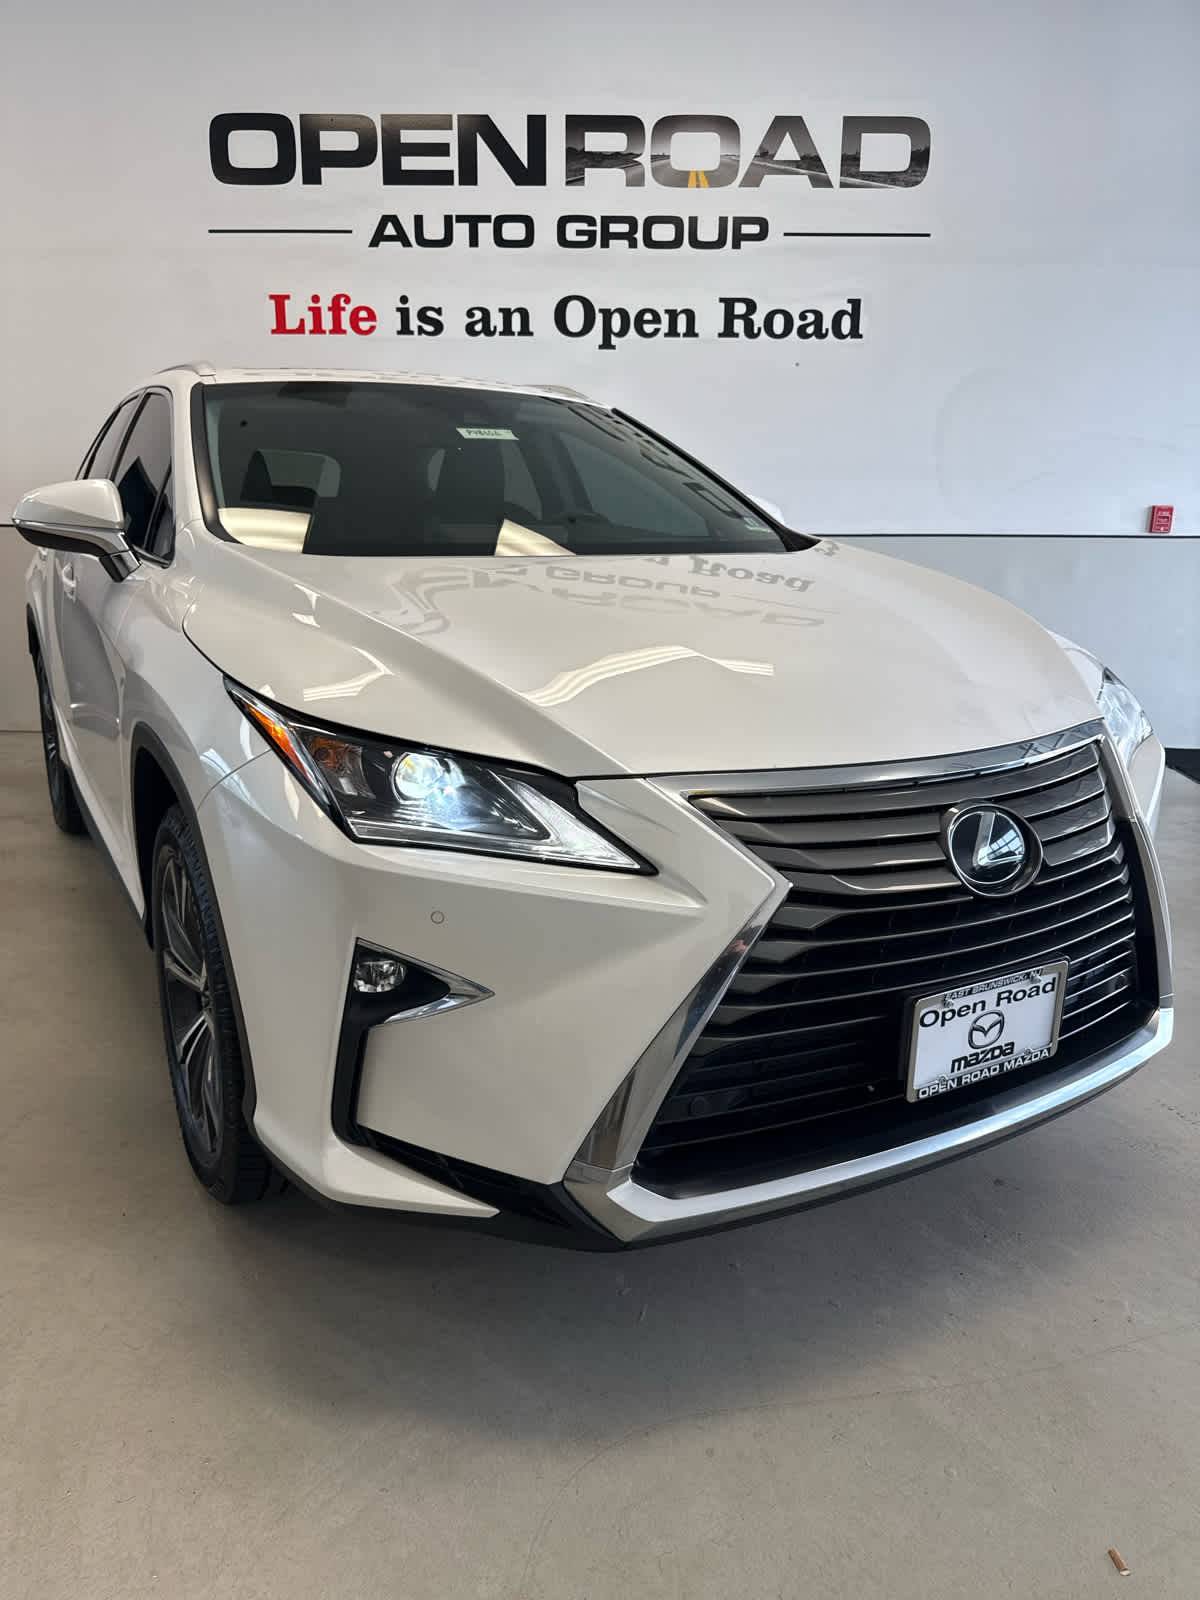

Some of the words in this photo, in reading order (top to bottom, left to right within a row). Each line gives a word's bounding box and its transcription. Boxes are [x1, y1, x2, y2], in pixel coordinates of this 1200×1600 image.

[209, 113, 546, 186] OPEN
[565, 114, 931, 189] ROAD
[368, 213, 535, 248] AUTO
[557, 215, 769, 250] GROUP
[268, 293, 377, 336] Life
[396, 295, 444, 337] is
[465, 306, 534, 337] an
[554, 295, 699, 350] Open
[717, 297, 863, 340] Road
[919, 1000, 986, 1028] Open
[996, 977, 1056, 1007] Road
[919, 1078, 958, 1099] OPEN
[961, 1065, 1000, 1085] ROAD
[1003, 1048, 1050, 1072] MAZDA
[951, 1041, 1015, 1073] mazda
